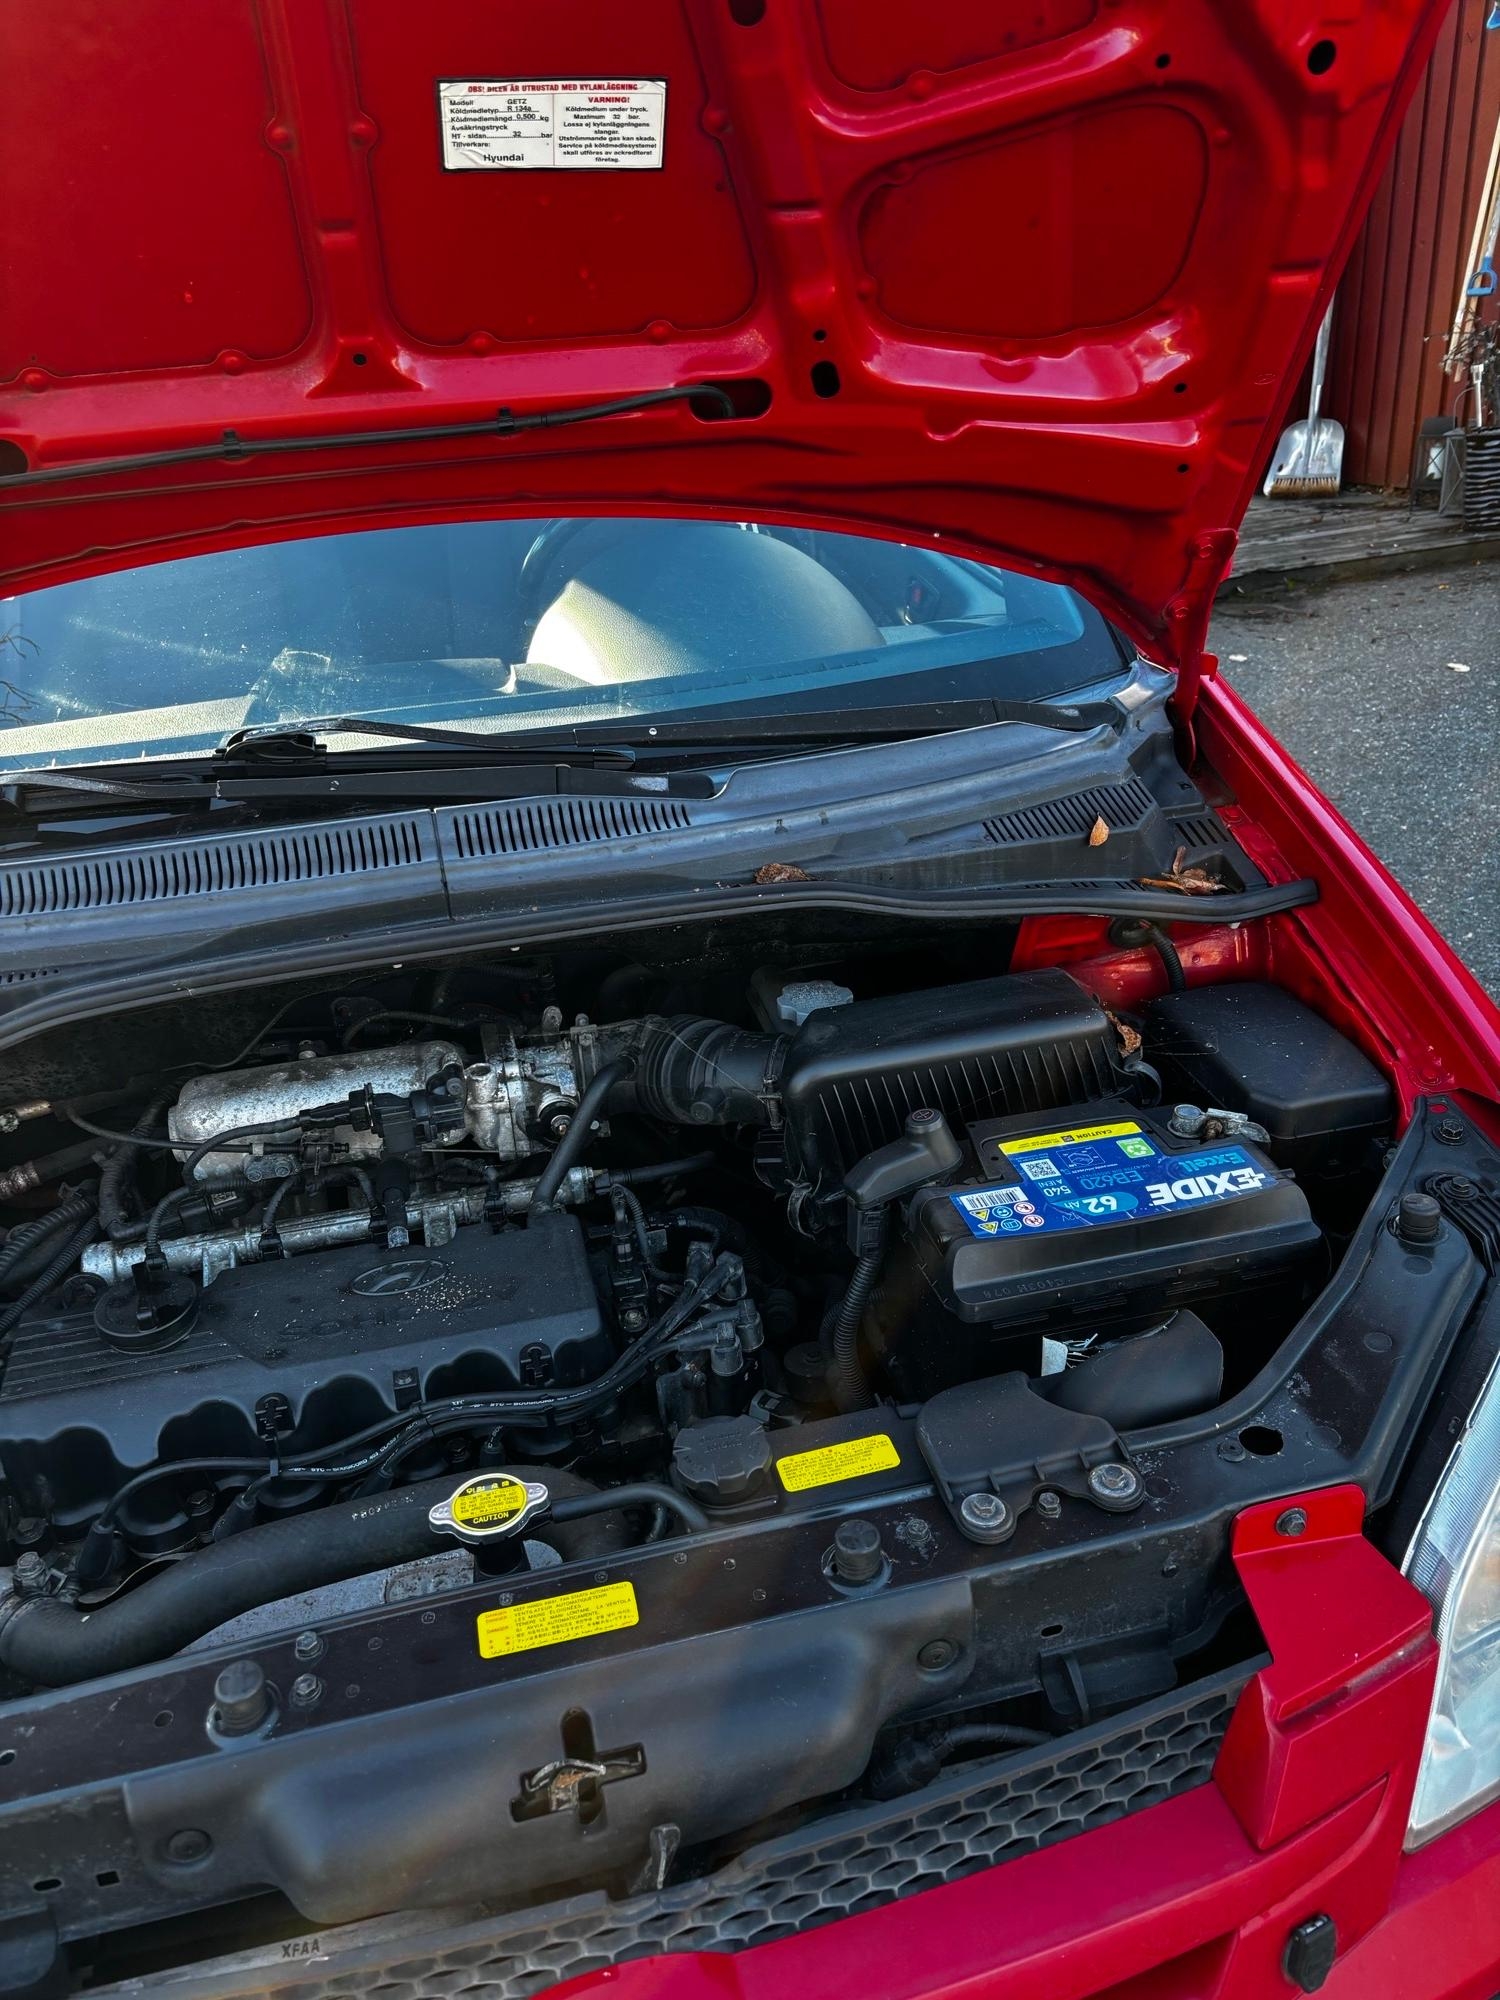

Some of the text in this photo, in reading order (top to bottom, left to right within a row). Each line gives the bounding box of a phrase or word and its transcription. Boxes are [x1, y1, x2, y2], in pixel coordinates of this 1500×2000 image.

[510, 84, 519, 92] ÄR
[580, 82, 638, 90] KYLANLÄGGNING
[484, 154, 524, 163] Hyundai
[1076, 1129, 1112, 1139] CAUTION
[1178, 1152, 1245, 1172] Excell
[1080, 1170, 1144, 1190] EB620
[1044, 1185, 1071, 1197] 540
[1146, 1168, 1266, 1206] EXIDE
[1064, 1196, 1118, 1213] 62 Ah
[1062, 1212, 1080, 1222] 12V
[473, 1512, 509, 1524] CAUTION
[282, 1939, 319, 1958] XFAA
